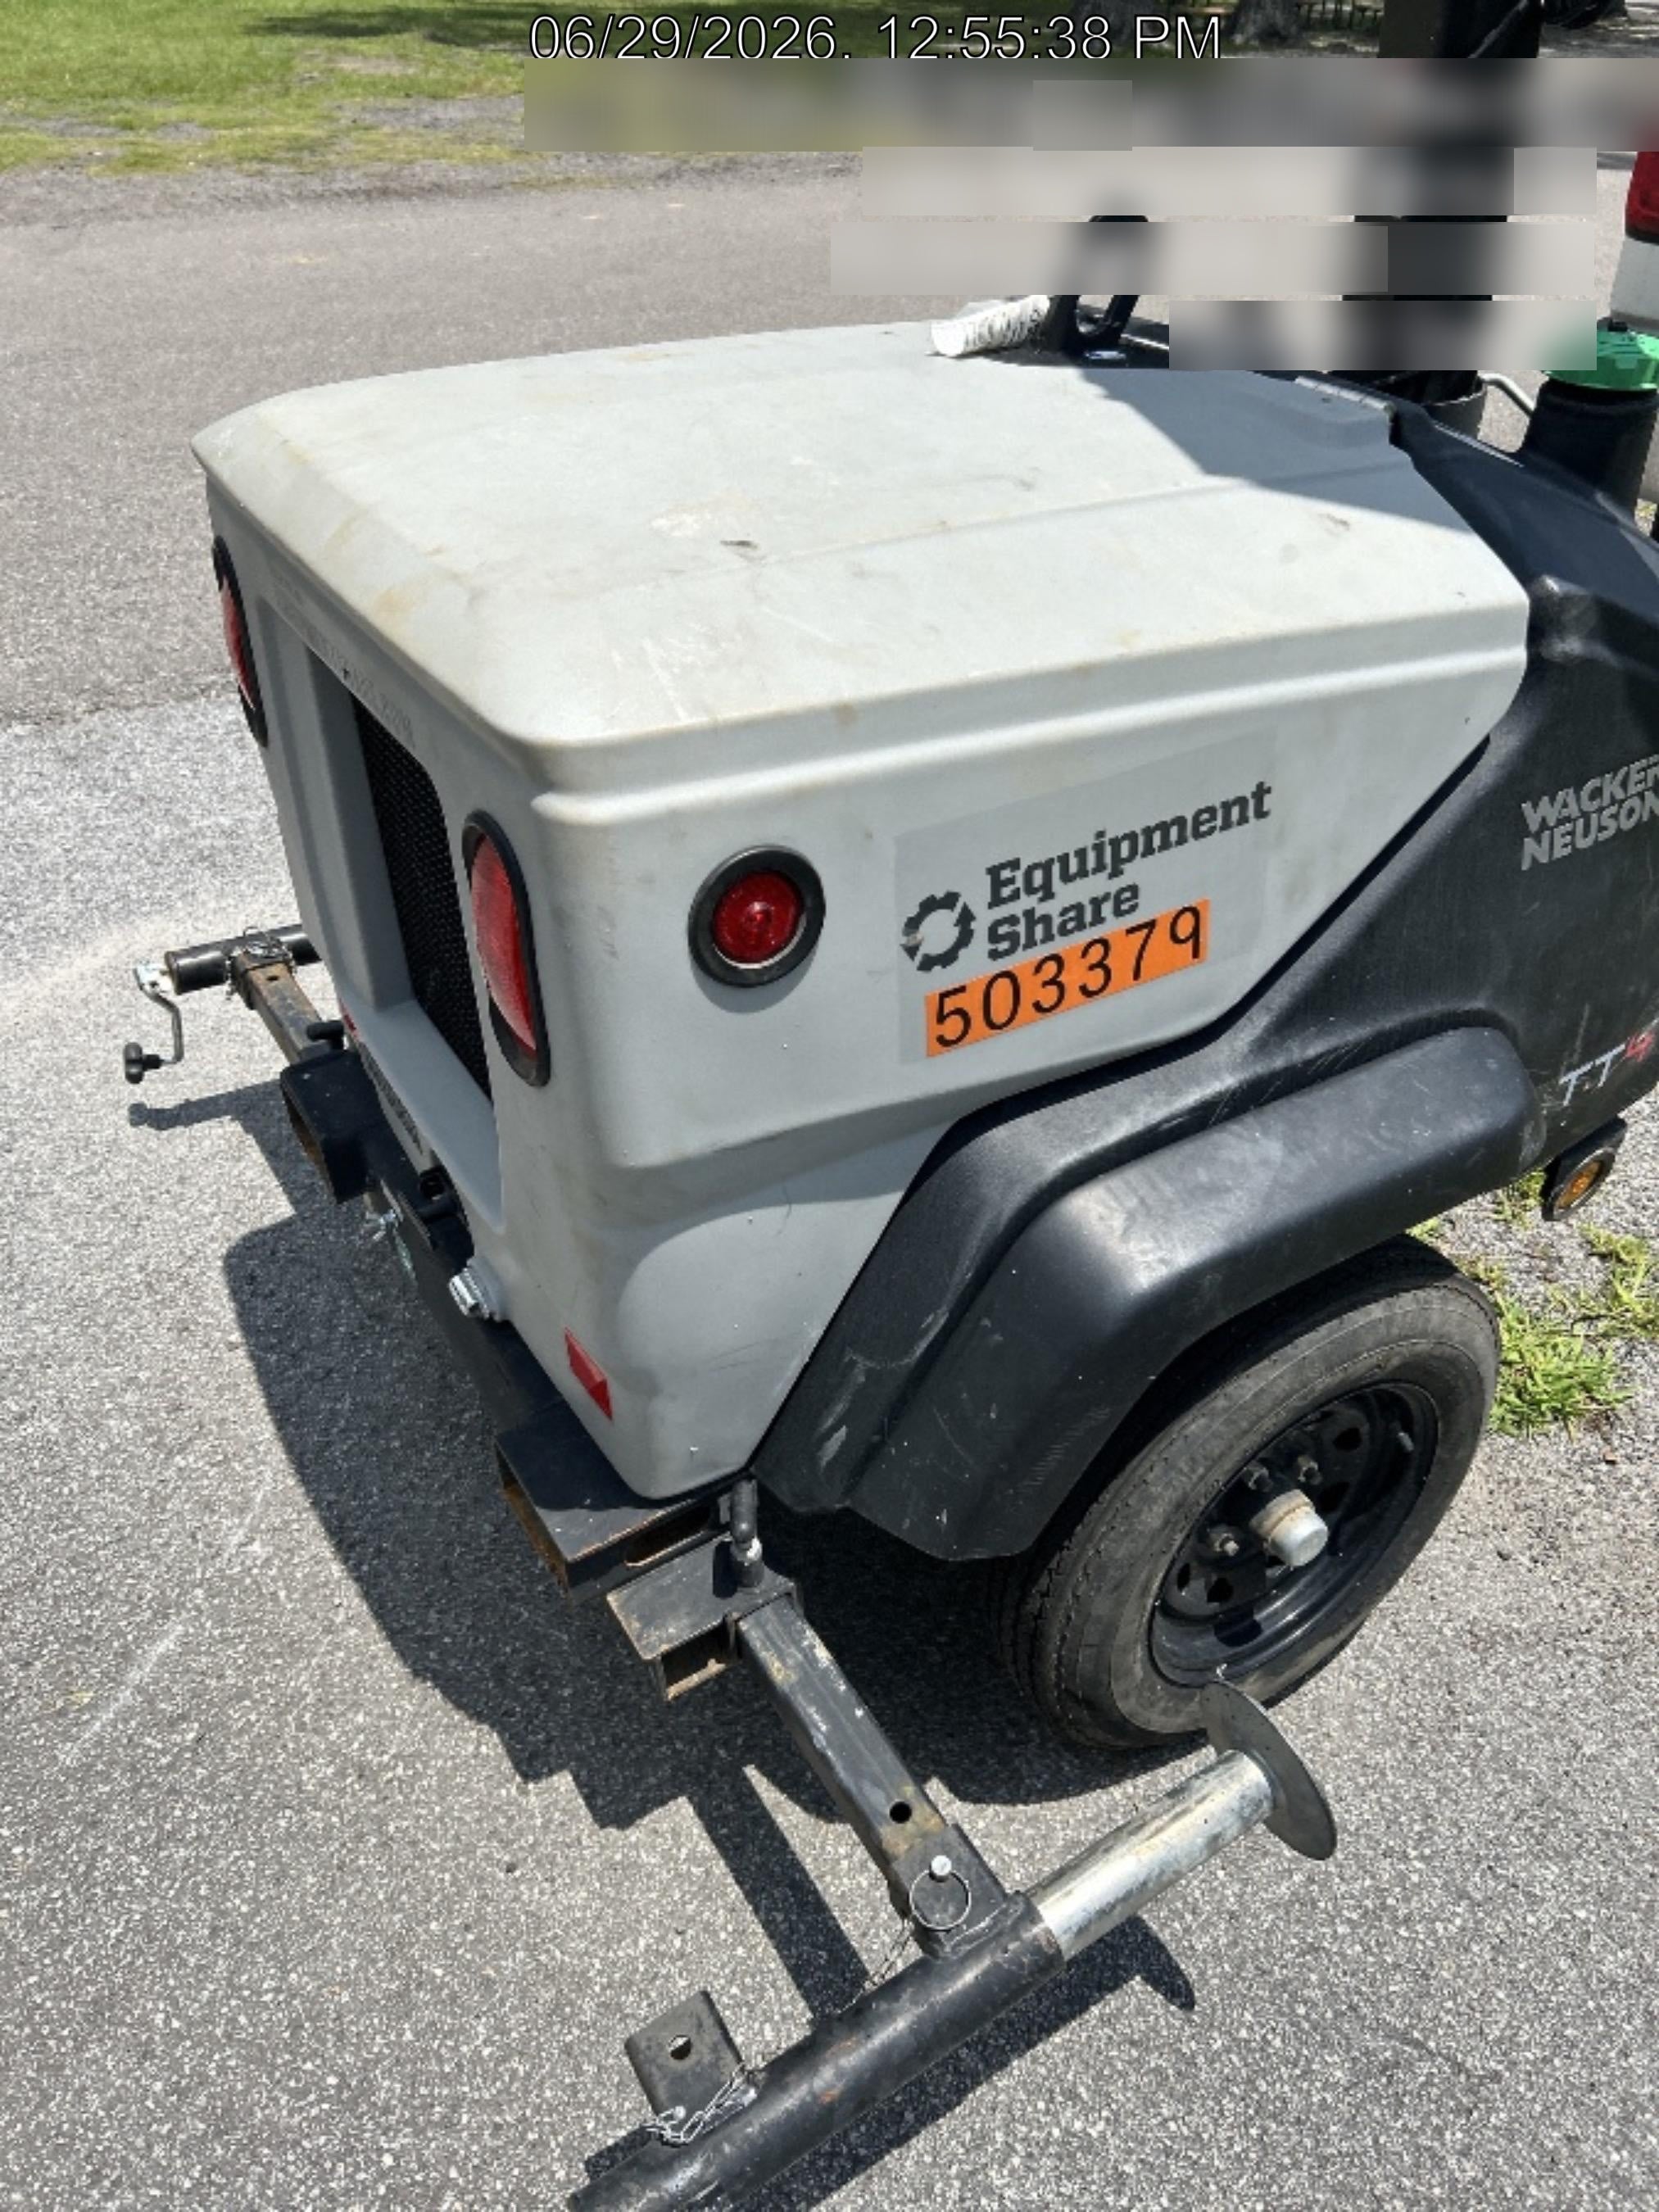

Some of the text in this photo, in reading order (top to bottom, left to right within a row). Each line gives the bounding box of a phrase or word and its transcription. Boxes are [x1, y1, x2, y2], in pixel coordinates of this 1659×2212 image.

[986, 780, 1272, 909] Equipment
[934, 904, 1203, 1048] 503379
[987, 882, 1140, 962] Share
